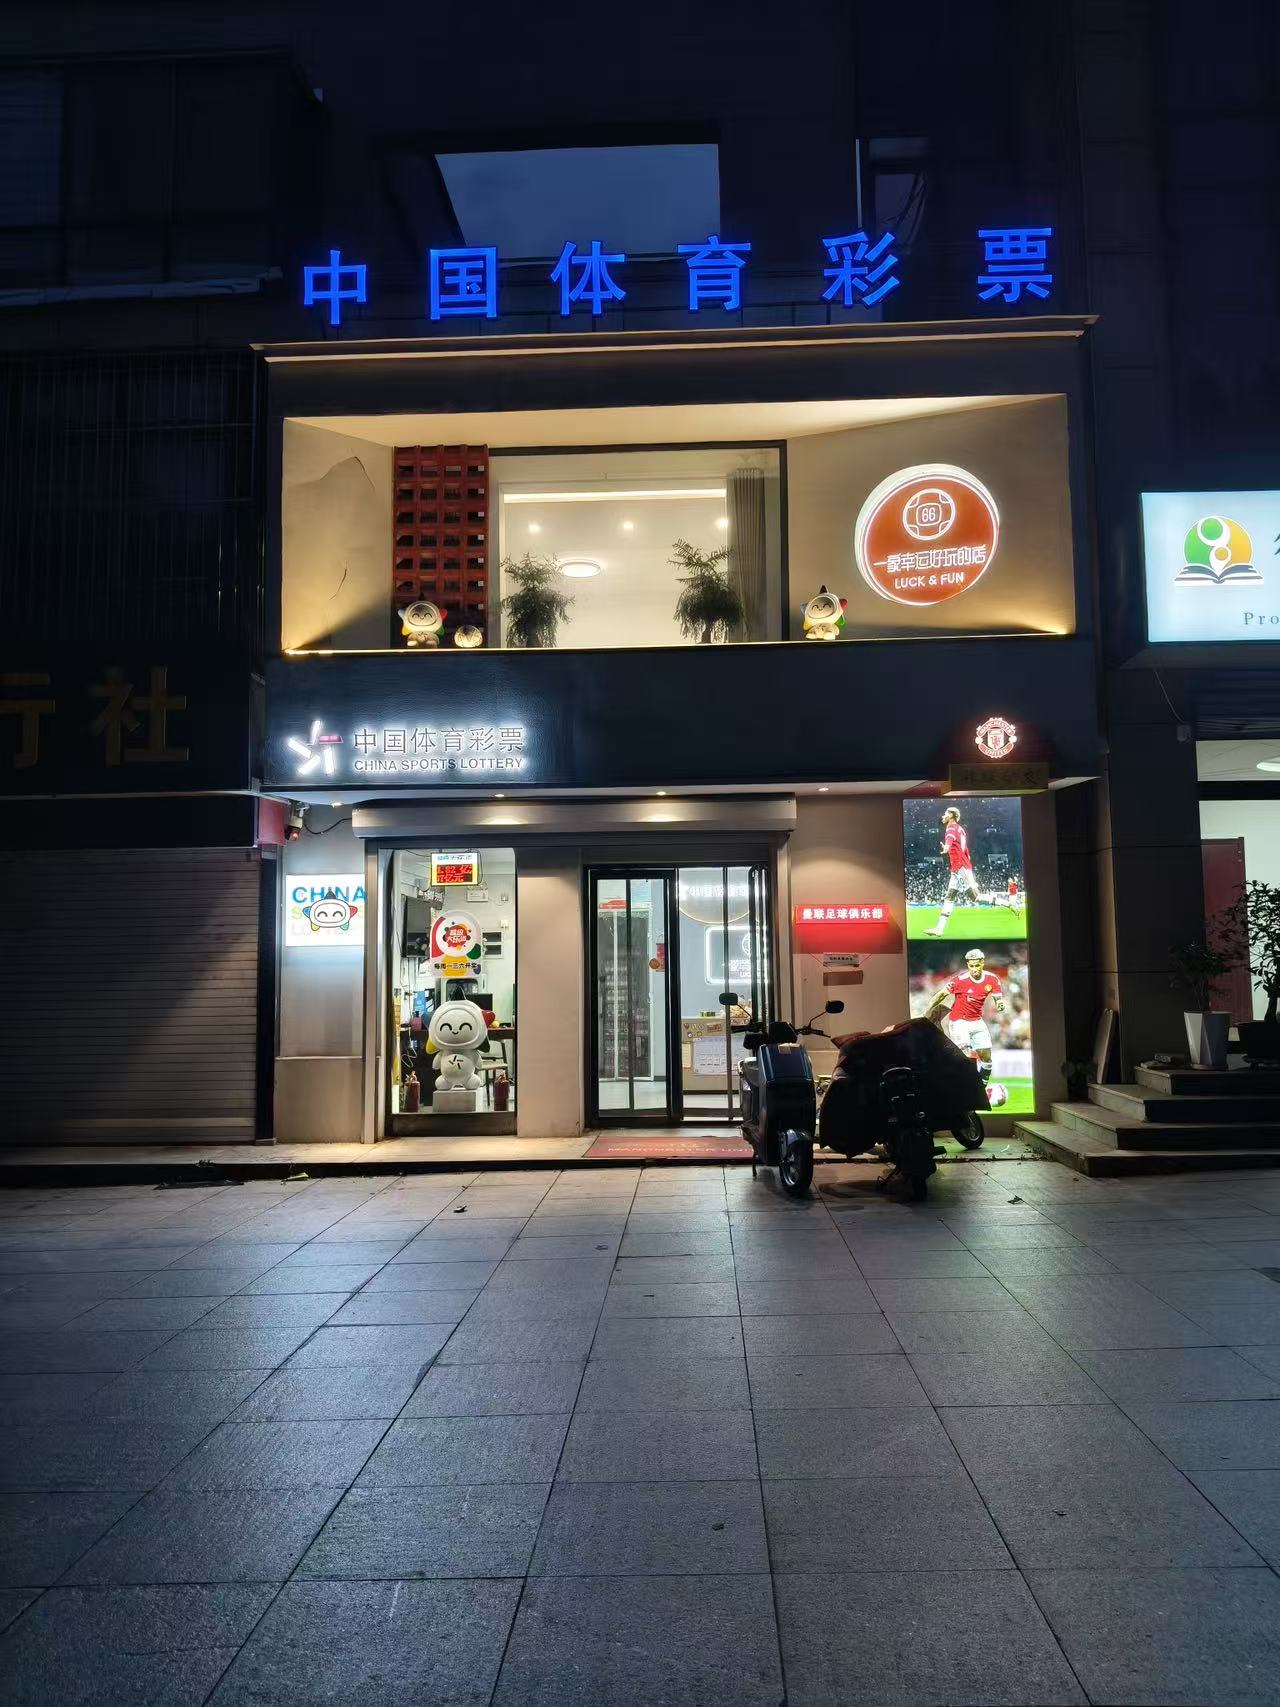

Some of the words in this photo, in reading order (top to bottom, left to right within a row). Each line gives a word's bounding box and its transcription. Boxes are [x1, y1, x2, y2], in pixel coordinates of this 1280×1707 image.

[303, 227, 1053, 326] 中国体育彩票
[873, 544, 987, 573] 一家幸运好玩的店
[894, 575, 926, 589] LUCK
[928, 574, 938, 586] &
[940, 571, 965, 585] FUN
[353, 727, 525, 754] 中国体育彩票
[353, 759, 398, 771] CHINA
[400, 758, 457, 771] SPORTS
[460, 757, 524, 770] LOTTERY
[802, 908, 883, 920] 曼联足球俱乐部
